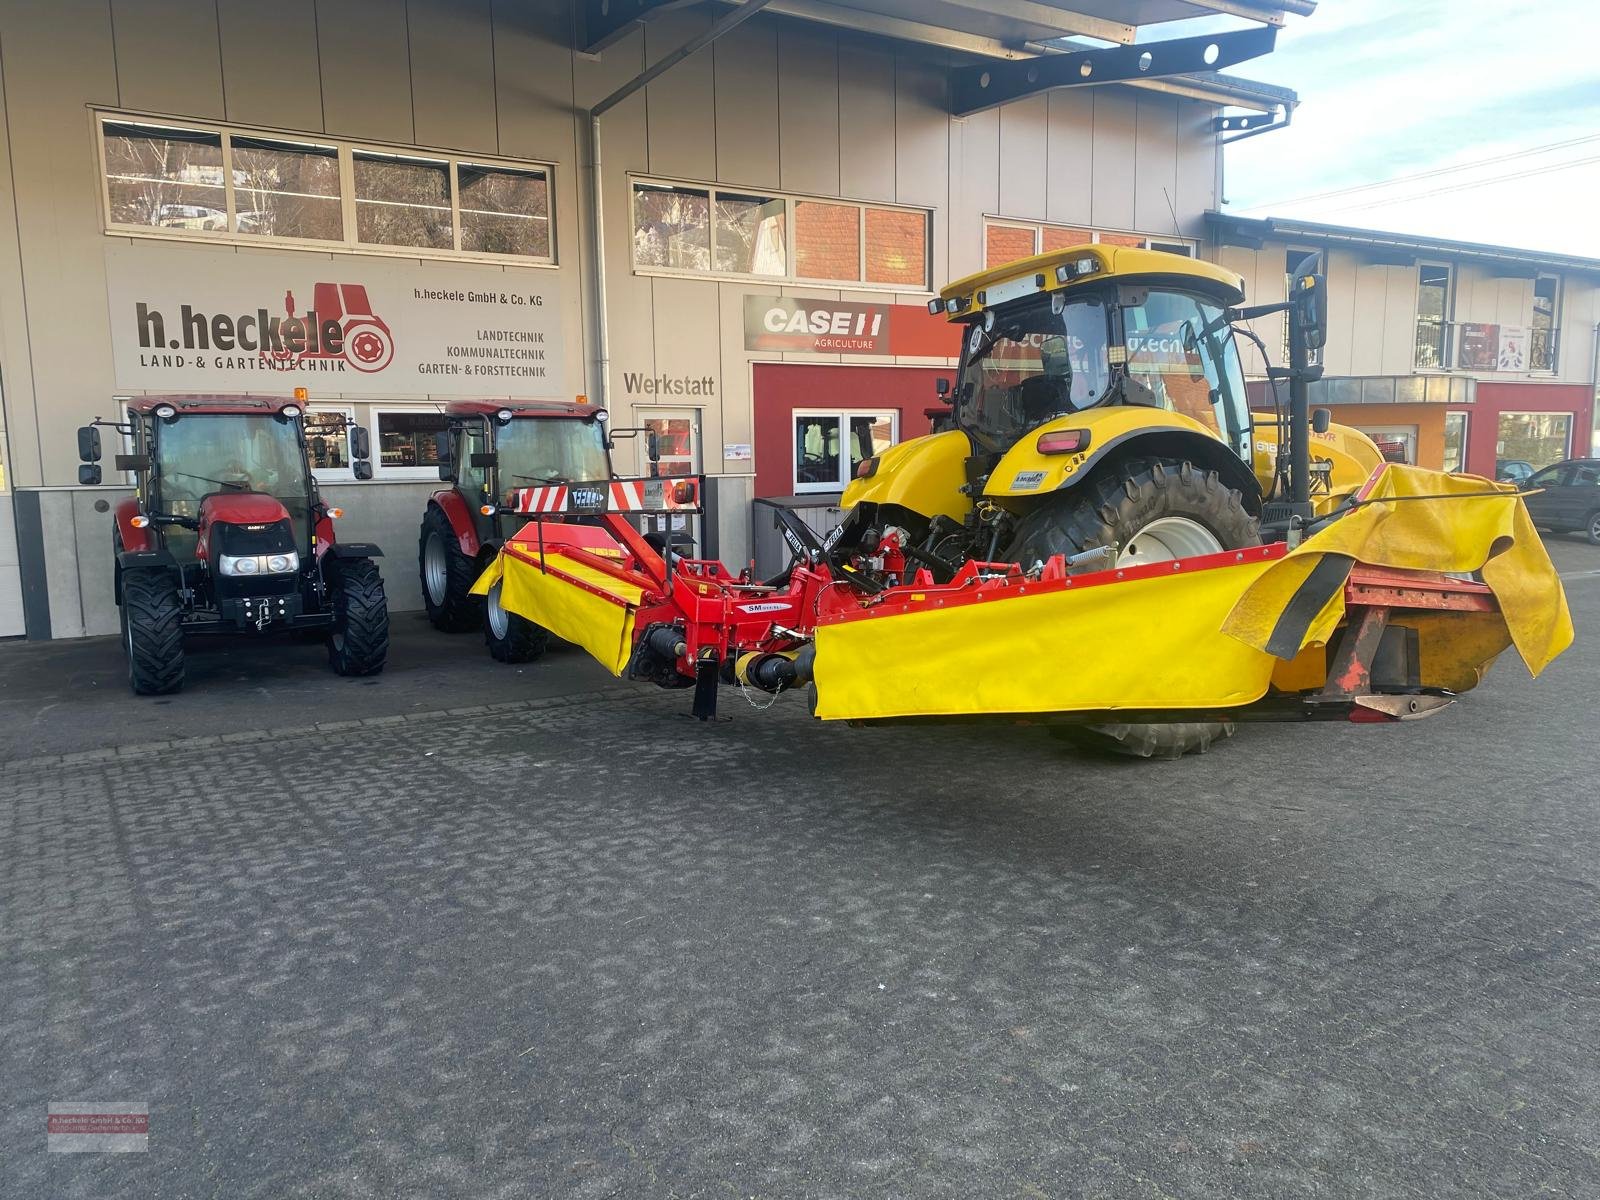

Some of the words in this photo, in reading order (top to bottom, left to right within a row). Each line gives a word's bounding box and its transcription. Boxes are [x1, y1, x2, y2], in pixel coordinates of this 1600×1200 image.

[414, 288, 465, 302] h.heckele
[468, 291, 497, 303] GmbH
[500, 293, 508, 304] &
[511, 294, 527, 305] Co.
[529, 295, 543, 306] KG
[135, 302, 345, 353] h.heckele
[763, 308, 852, 335] CASE
[477, 330, 544, 343] LANDTECHNIK
[814, 339, 873, 349] AGRICULTURE
[447, 346, 545, 360] KOMMUNALTECHNIK
[214, 356, 346, 372] GARTENTECHNIK
[418, 363, 462, 375] GARTEN-
[465, 364, 472, 375] &
[474, 364, 546, 378] FORSTTECHNIK
[623, 373, 714, 396] Werkstatt
